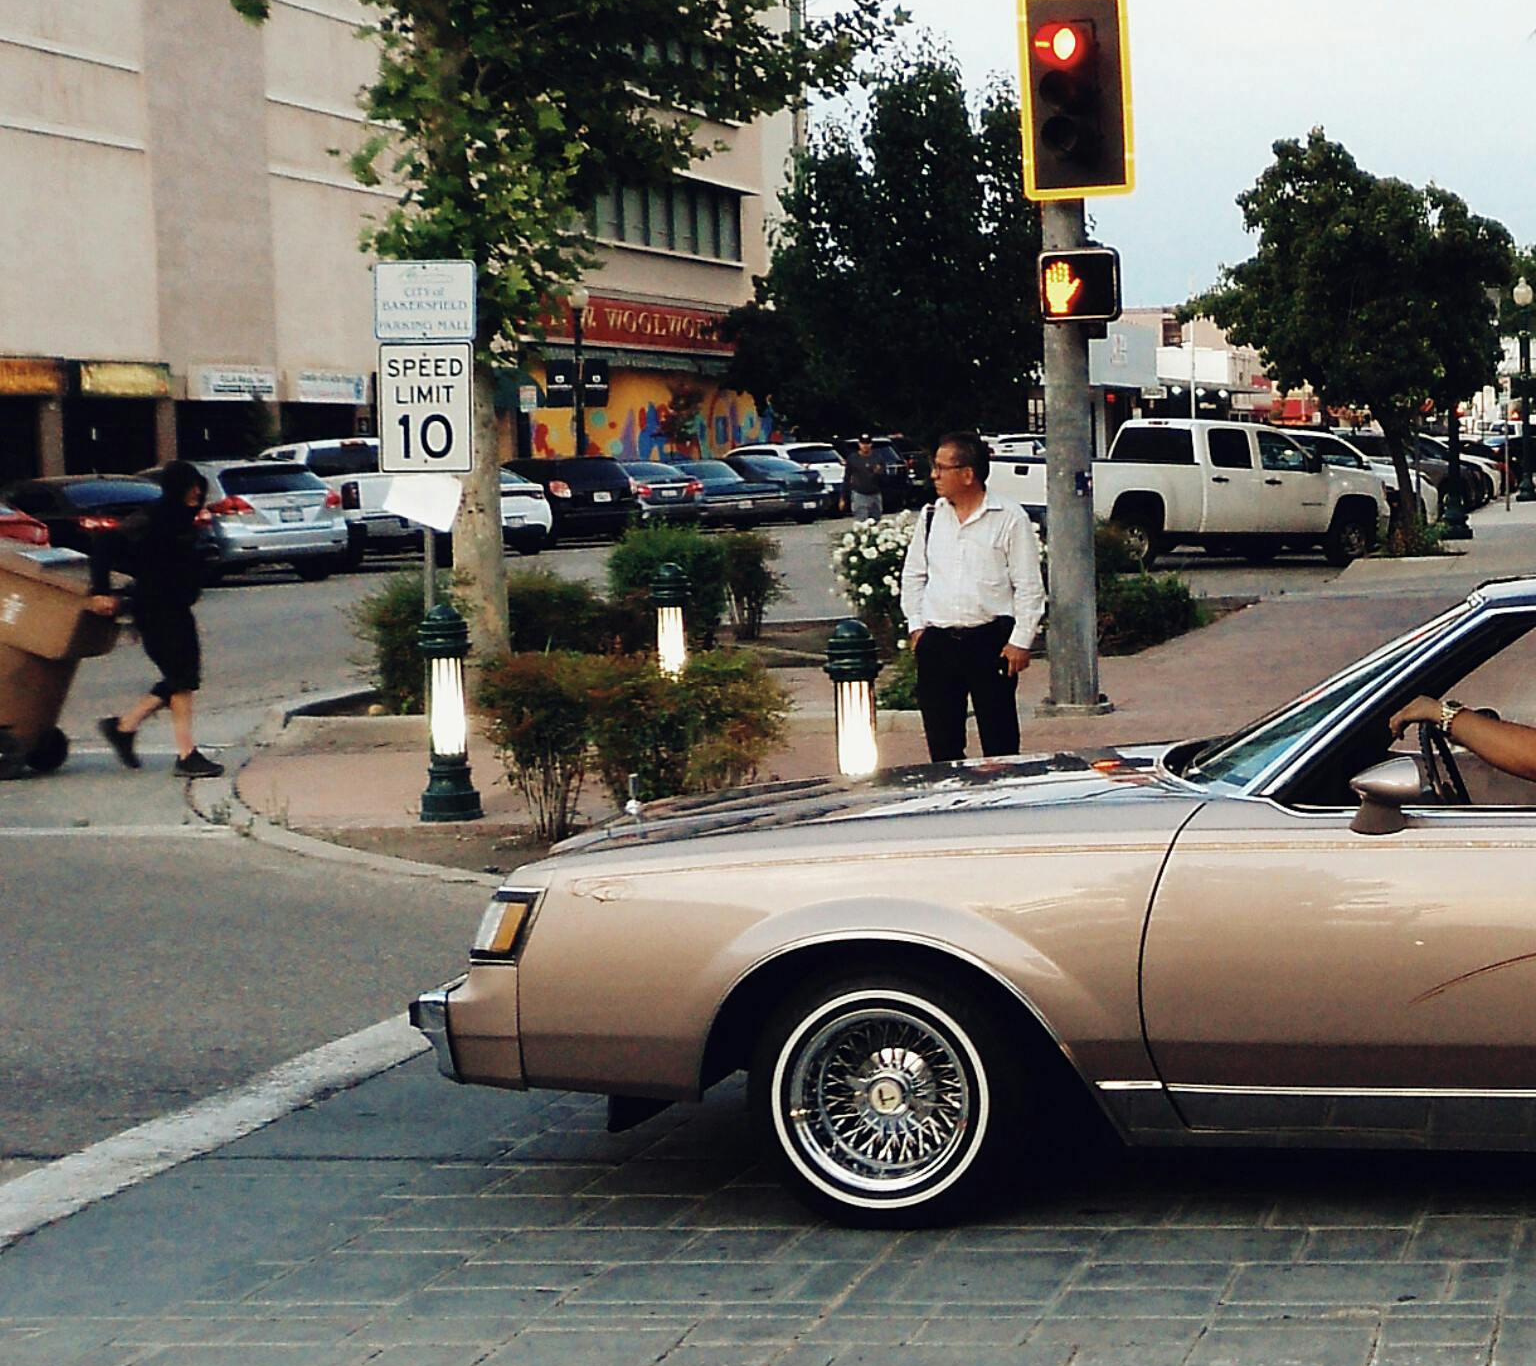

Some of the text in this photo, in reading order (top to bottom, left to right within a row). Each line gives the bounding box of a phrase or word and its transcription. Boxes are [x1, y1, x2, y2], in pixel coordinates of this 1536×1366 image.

[404, 287, 430, 298] CITY
[382, 300, 468, 312] BAKERSFIELD
[387, 358, 464, 378] SPEED
[395, 385, 455, 405] LIMIT
[398, 413, 454, 460] 10
